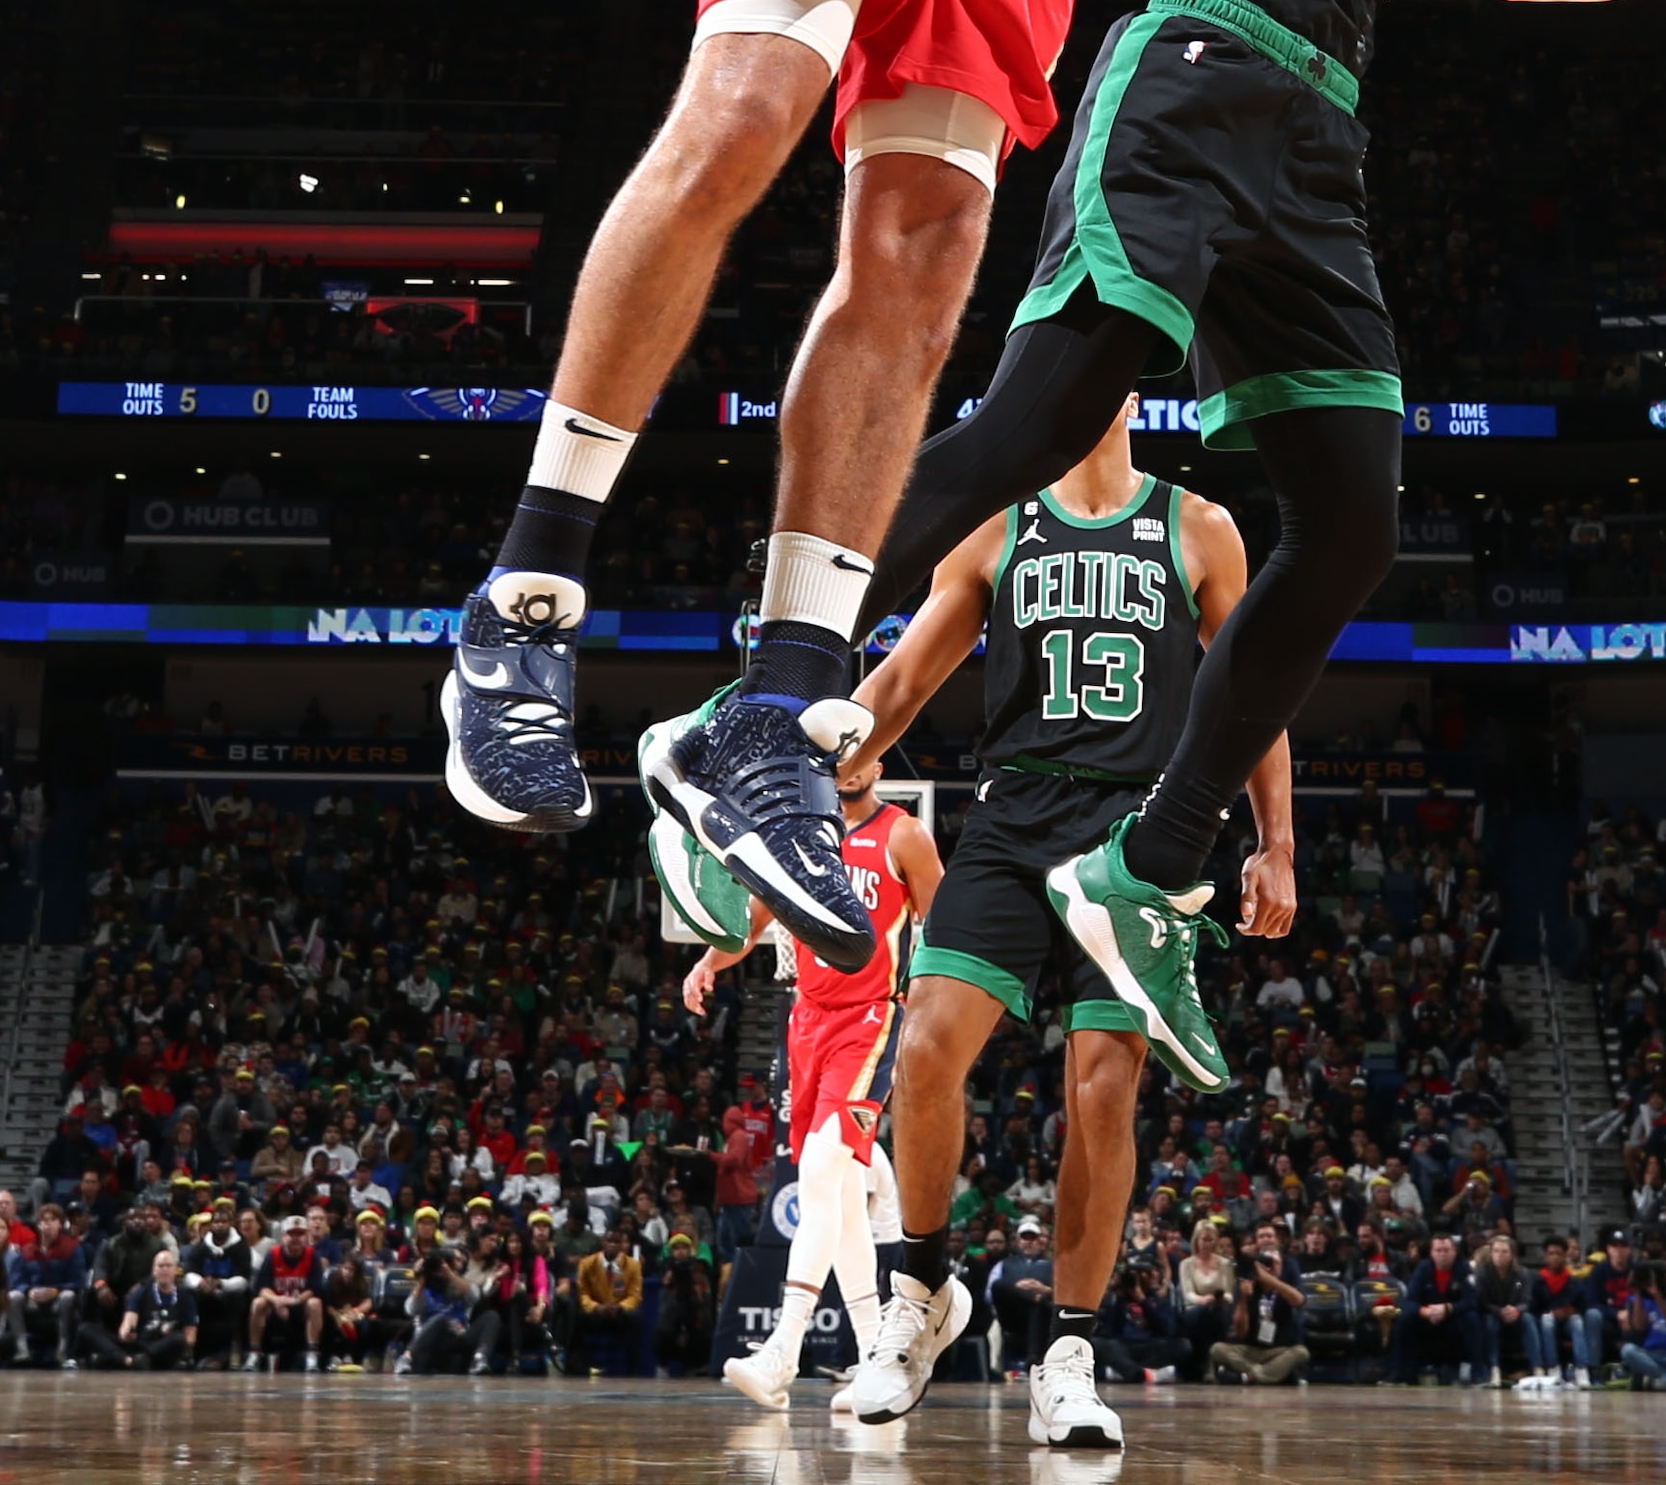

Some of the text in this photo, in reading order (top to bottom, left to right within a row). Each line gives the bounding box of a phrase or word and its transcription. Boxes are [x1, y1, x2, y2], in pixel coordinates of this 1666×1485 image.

[125, 382, 164, 399] TIME
[312, 386, 354, 403] TEAM
[122, 399, 164, 416] OUTS
[179, 388, 197, 415] 5
[252, 389, 270, 415] 0
[740, 401, 776, 418] 2nd
[1449, 403, 1488, 419] TIME
[308, 403, 358, 420] FOULS
[1126, 398, 1201, 432] LTIC
[1414, 406, 1431, 433] 6
[1449, 419, 1490, 436] OUTS
[183, 505, 319, 527] HUB CLUB
[1024, 501, 1039, 516] 6
[1132, 518, 1164, 533] VISTA
[1133, 531, 1165, 543] PRINT
[62, 567, 107, 583] HUB
[1013, 550, 1167, 632] CELTICS
[1519, 586, 1564, 605] HUB
[307, 607, 381, 643] NA
[1509, 626, 1586, 662] NA
[1041, 629, 1145, 723] 13
[227, 742, 410, 764] BETRIVERS
[1292, 759, 1426, 779] TRIVERS
